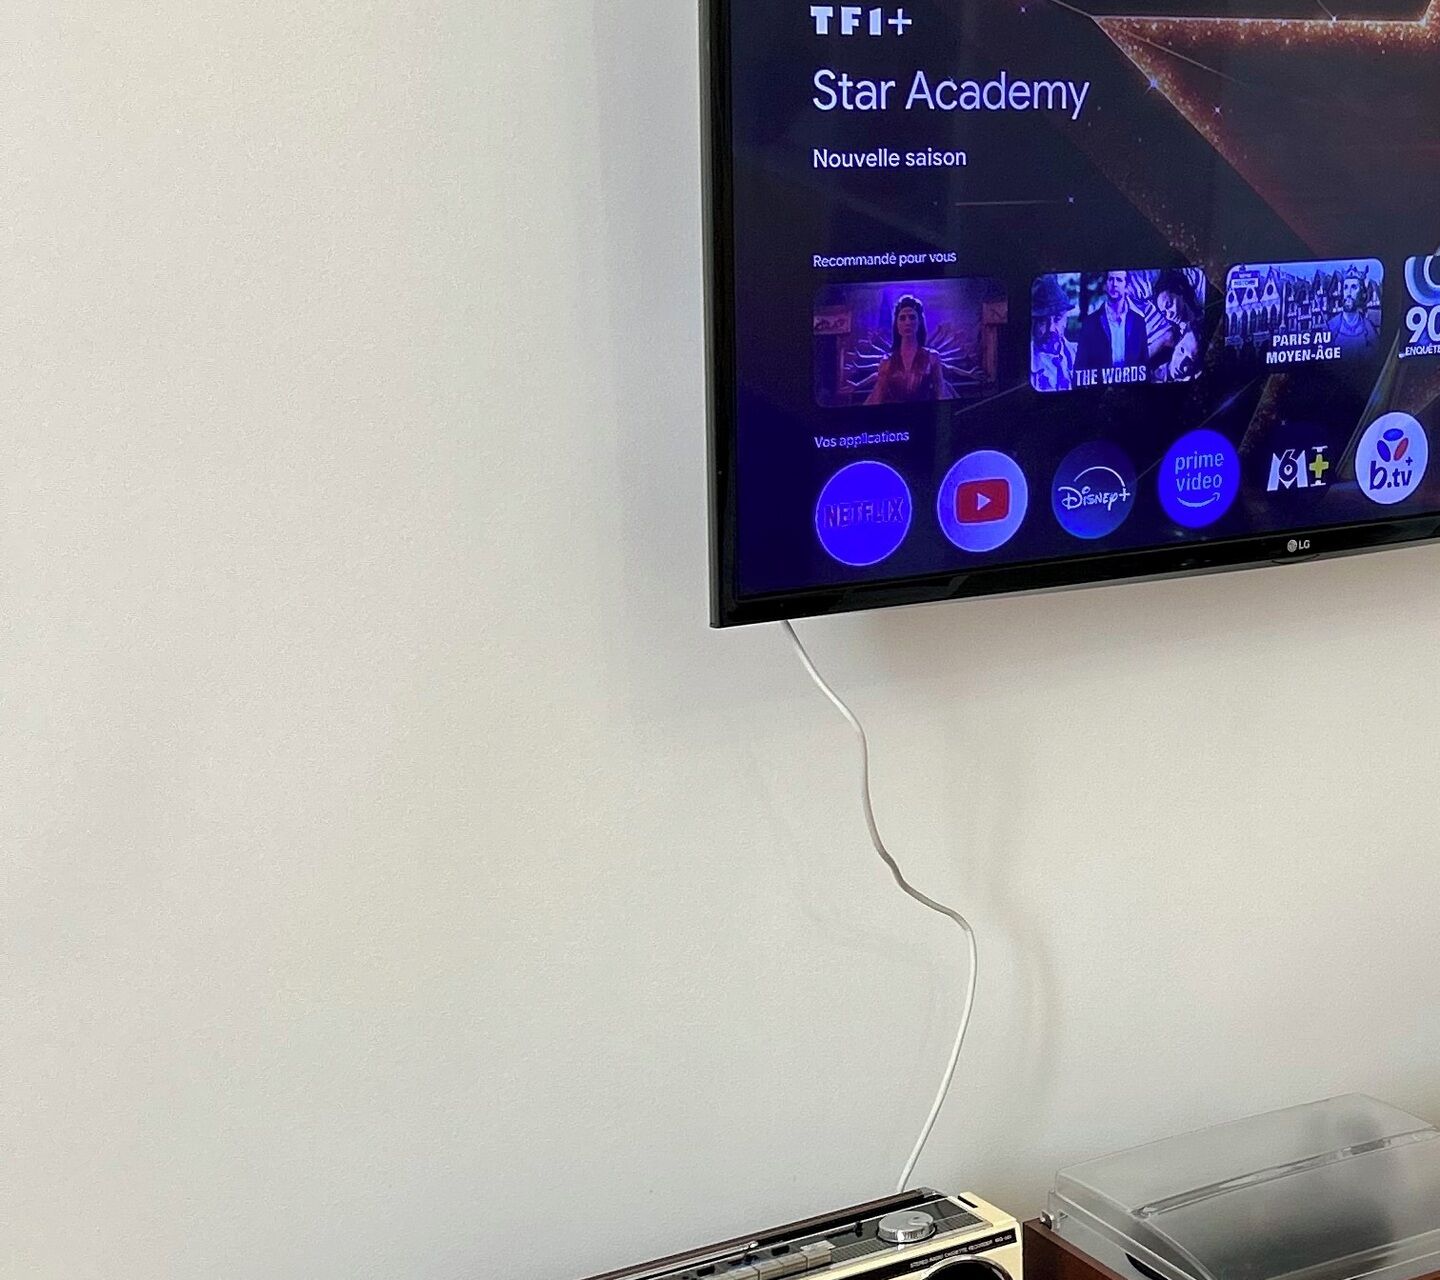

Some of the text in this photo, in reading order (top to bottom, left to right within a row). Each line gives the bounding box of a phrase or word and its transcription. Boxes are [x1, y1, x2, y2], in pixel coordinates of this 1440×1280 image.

[810, 5, 913, 37] TF1+
[812, 68, 1091, 121] Star Academy
[812, 148, 968, 170] Nouvelle saison
[813, 251, 957, 268] Recommandé pour vous
[1272, 331, 1332, 348] PARIS AU
[1265, 345, 1341, 364] MOYEN-ÂGE
[1075, 364, 1148, 387] THE WORDS
[813, 430, 910, 449] Vos applications
[1174, 450, 1225, 475] prime
[1176, 472, 1224, 493] video
[824, 496, 905, 530] NETFLIX
[1298, 539, 1311, 550] LG
